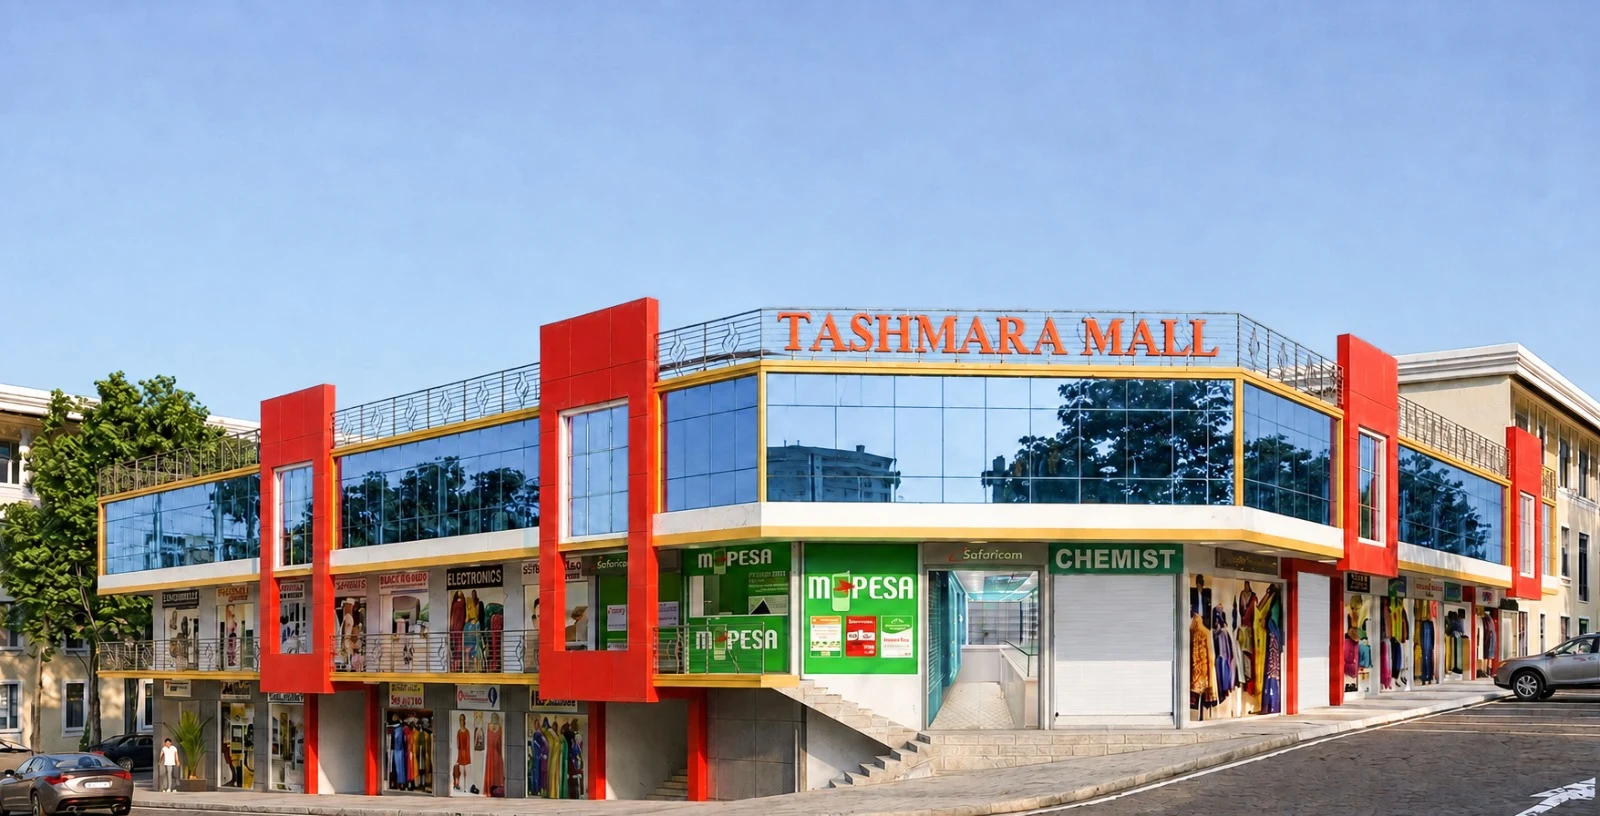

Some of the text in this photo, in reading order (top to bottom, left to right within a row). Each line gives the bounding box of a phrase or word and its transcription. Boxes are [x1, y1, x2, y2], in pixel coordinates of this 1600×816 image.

[777, 312, 1219, 358] TASHMARA MALL
[963, 549, 1023, 561] Safaricom
[1055, 548, 1176, 569] CHEMIST
[597, 559, 627, 570] Safarico
[447, 569, 502, 586] ELECTRONICS
